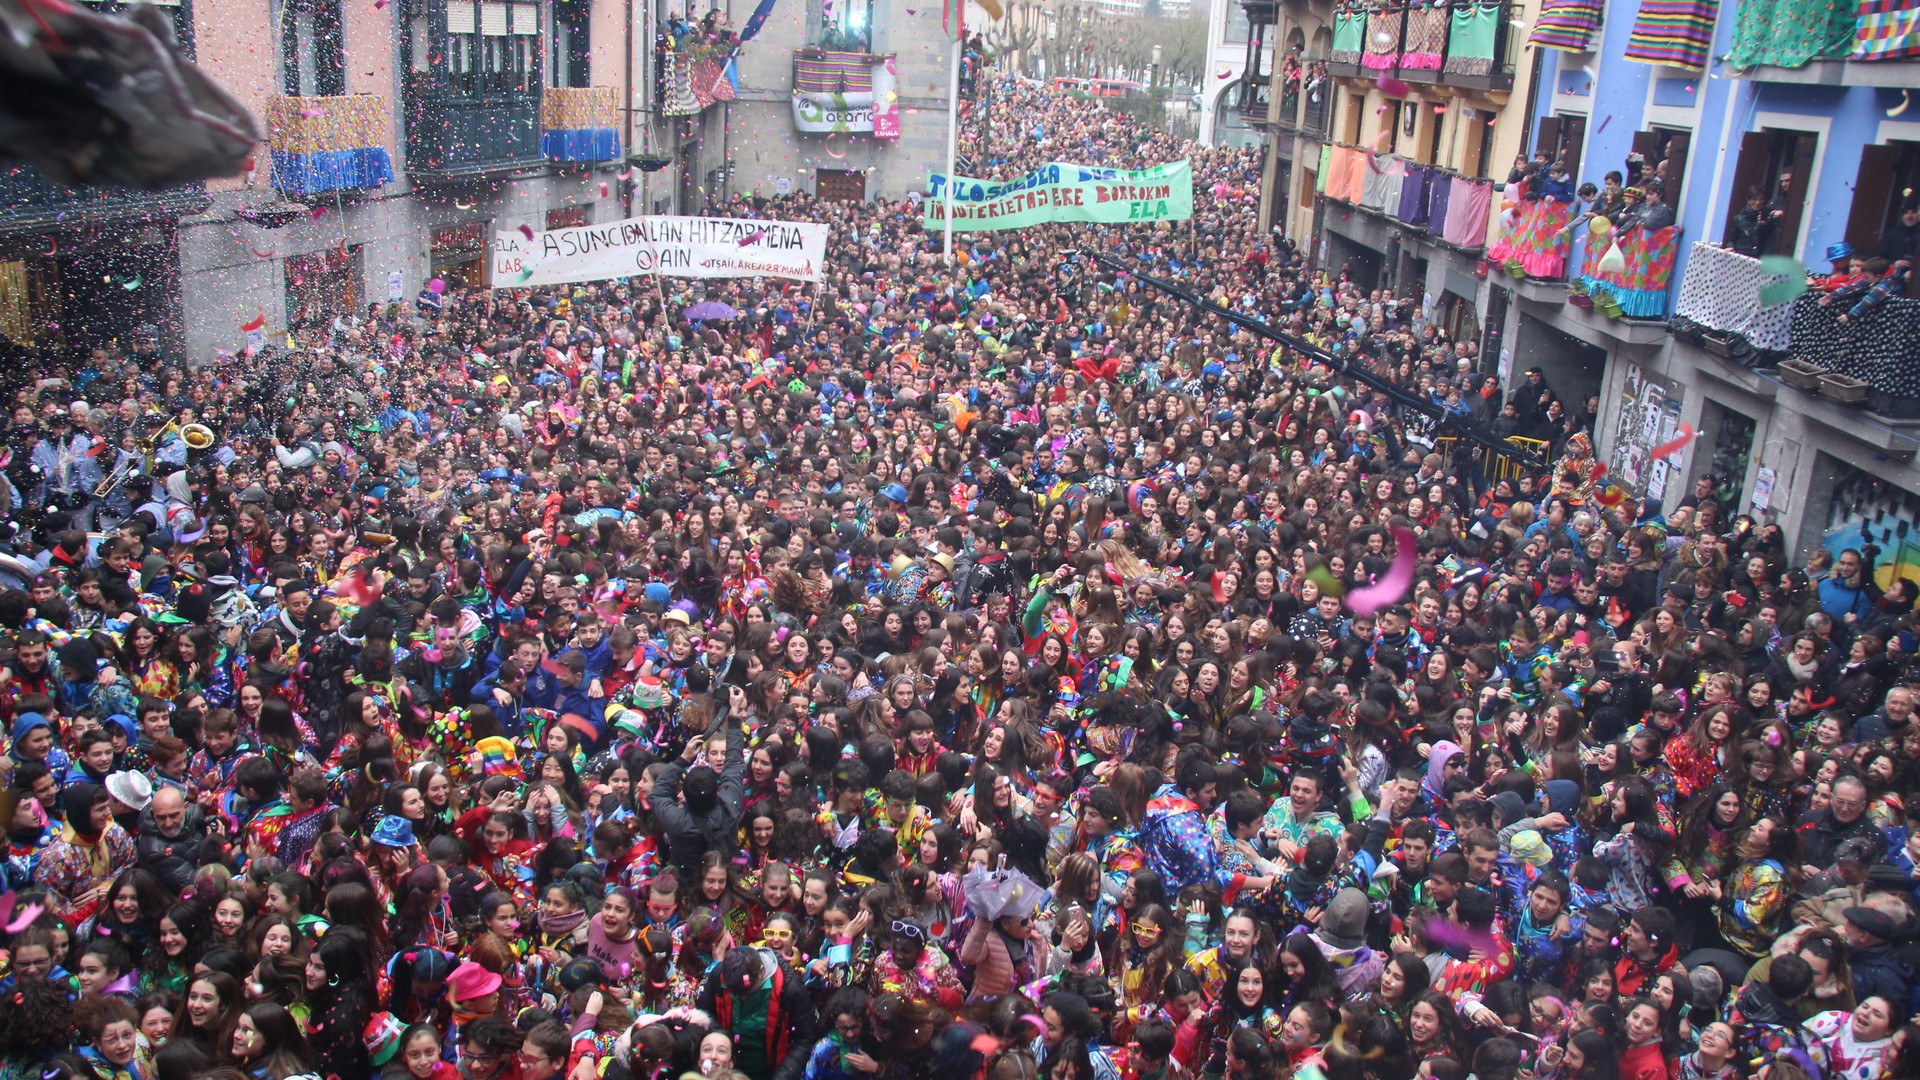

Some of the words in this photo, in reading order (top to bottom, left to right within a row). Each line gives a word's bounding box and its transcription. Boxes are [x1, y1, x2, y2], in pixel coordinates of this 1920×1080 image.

[1052, 187, 1084, 207] ERE
[1096, 185, 1170, 204] BORROKAN
[1128, 200, 1169, 219] ELA
[651, 220, 682, 243] LAN
[690, 219, 803, 250] HITZARMENA
[495, 239, 519, 252] ELA
[497, 257, 522, 274] LAB
[781, 265, 814, 277] MANIA
[592, 944, 618, 967] Make
